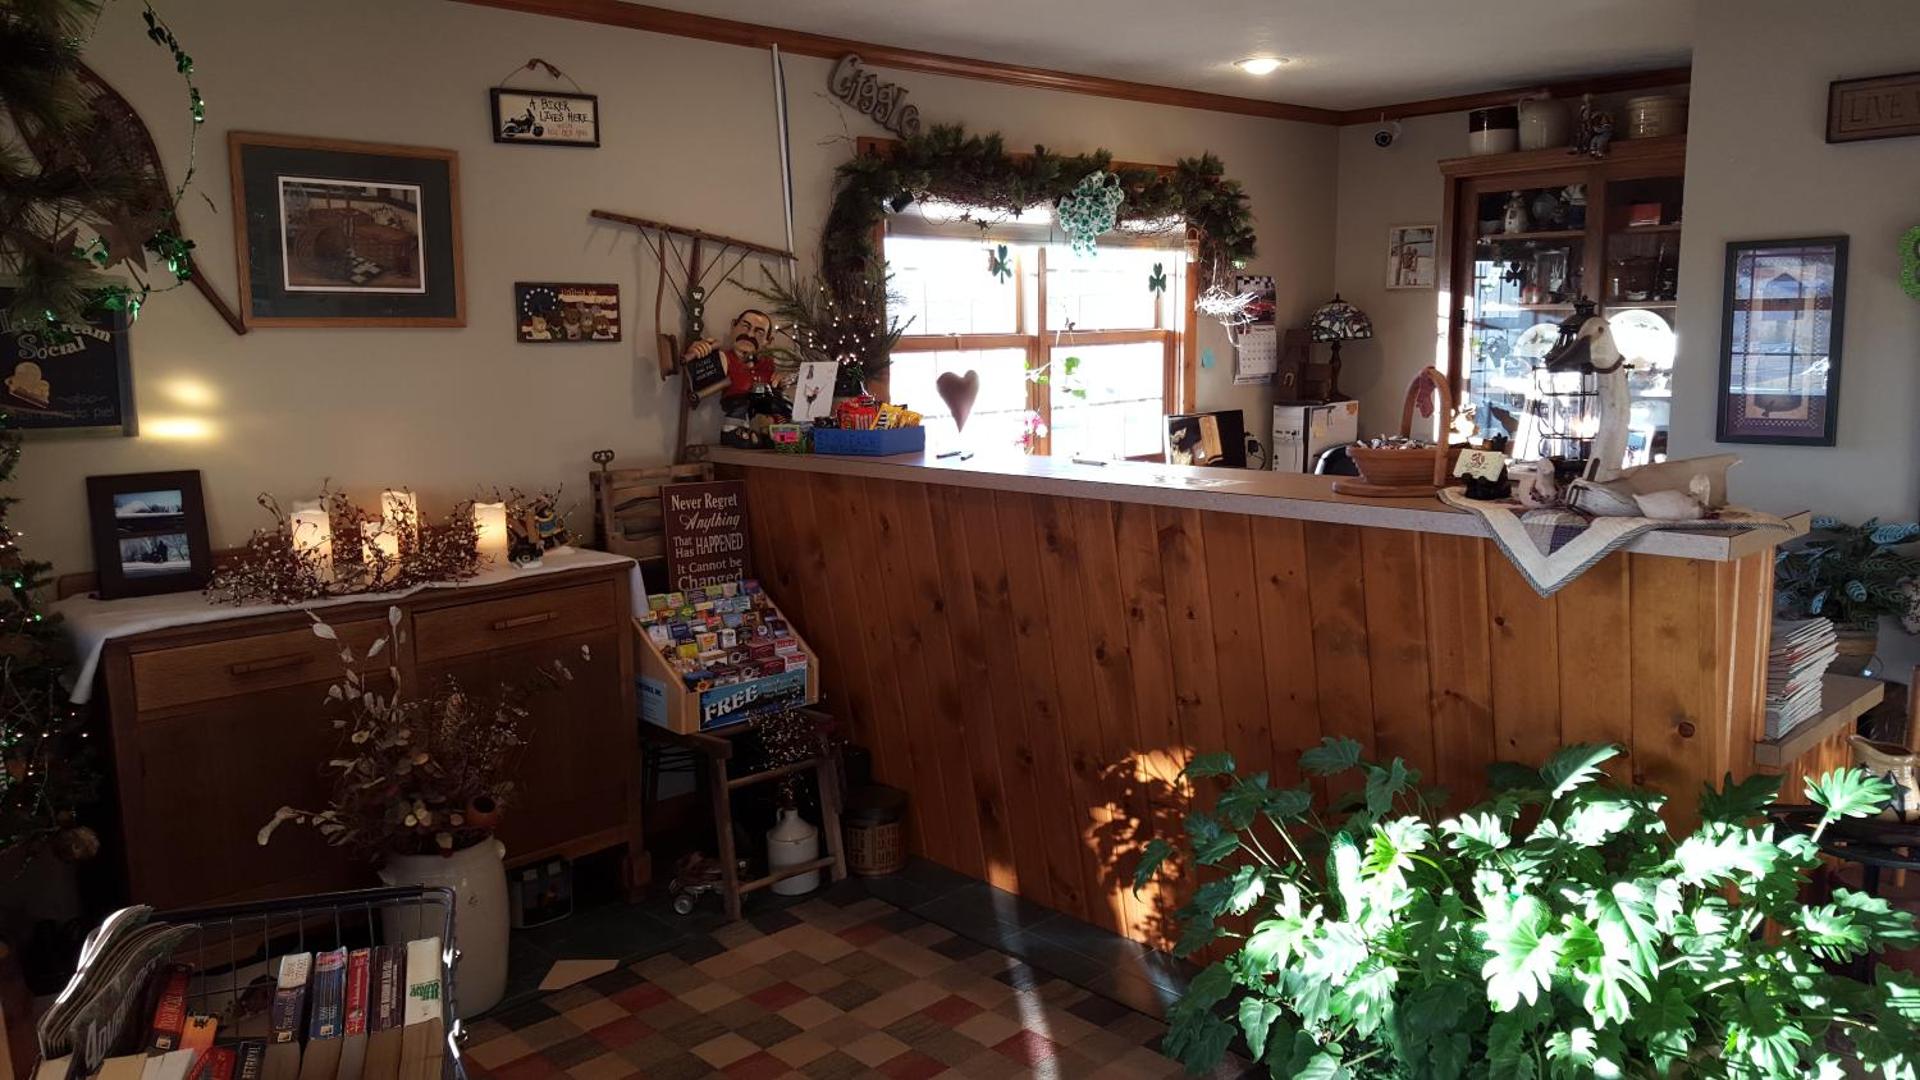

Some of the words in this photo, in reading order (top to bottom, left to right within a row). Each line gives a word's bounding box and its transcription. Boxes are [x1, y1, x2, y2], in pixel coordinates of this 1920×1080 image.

[529, 97, 536, 110] A
[541, 98, 571, 111] BIKER
[828, 53, 921, 141] Giggle
[540, 110, 564, 122] LIVES
[567, 112, 589, 123] HERE
[1849, 94, 1904, 123] LIVE
[61, 322, 112, 343] ream
[18, 335, 87, 359] Social
[671, 494, 702, 511] Never
[704, 492, 738, 510] Regret
[679, 511, 741, 533] Anything
[672, 535, 693, 546] That
[675, 547, 694, 559] Has
[696, 532, 743, 555] HAPPENED
[677, 563, 686, 575] It
[689, 560, 727, 573] Cannot
[729, 556, 743, 568] be
[678, 567, 743, 592] Changed
[704, 684, 759, 722] FREE
